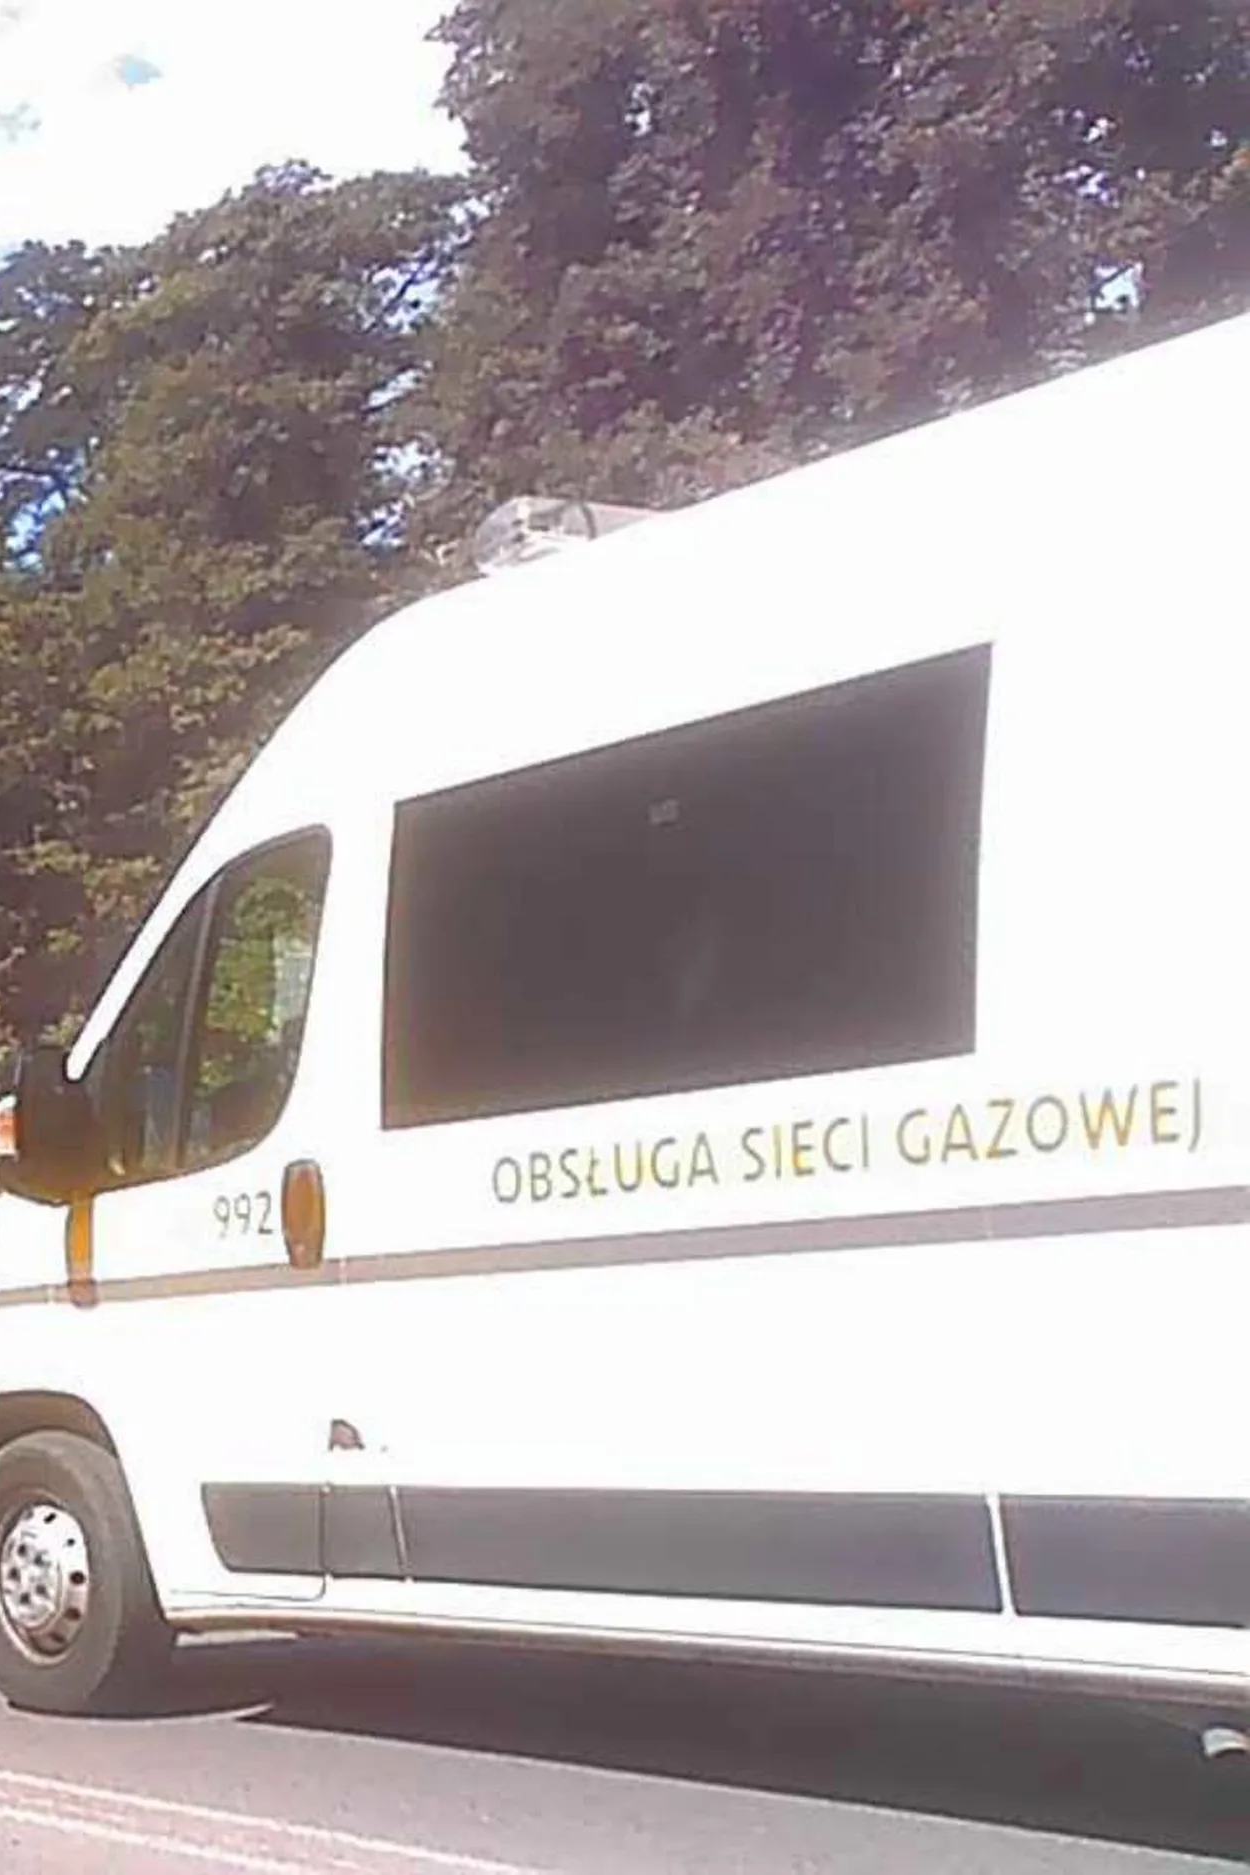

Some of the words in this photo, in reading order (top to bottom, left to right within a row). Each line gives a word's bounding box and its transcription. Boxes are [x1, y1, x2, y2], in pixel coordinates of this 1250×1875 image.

[491, 1131, 719, 1205] OBSŁUGA
[742, 1112, 870, 1182] SIECI
[895, 1078, 1202, 1166] GAZOWEJ
[213, 1190, 274, 1238] 992
